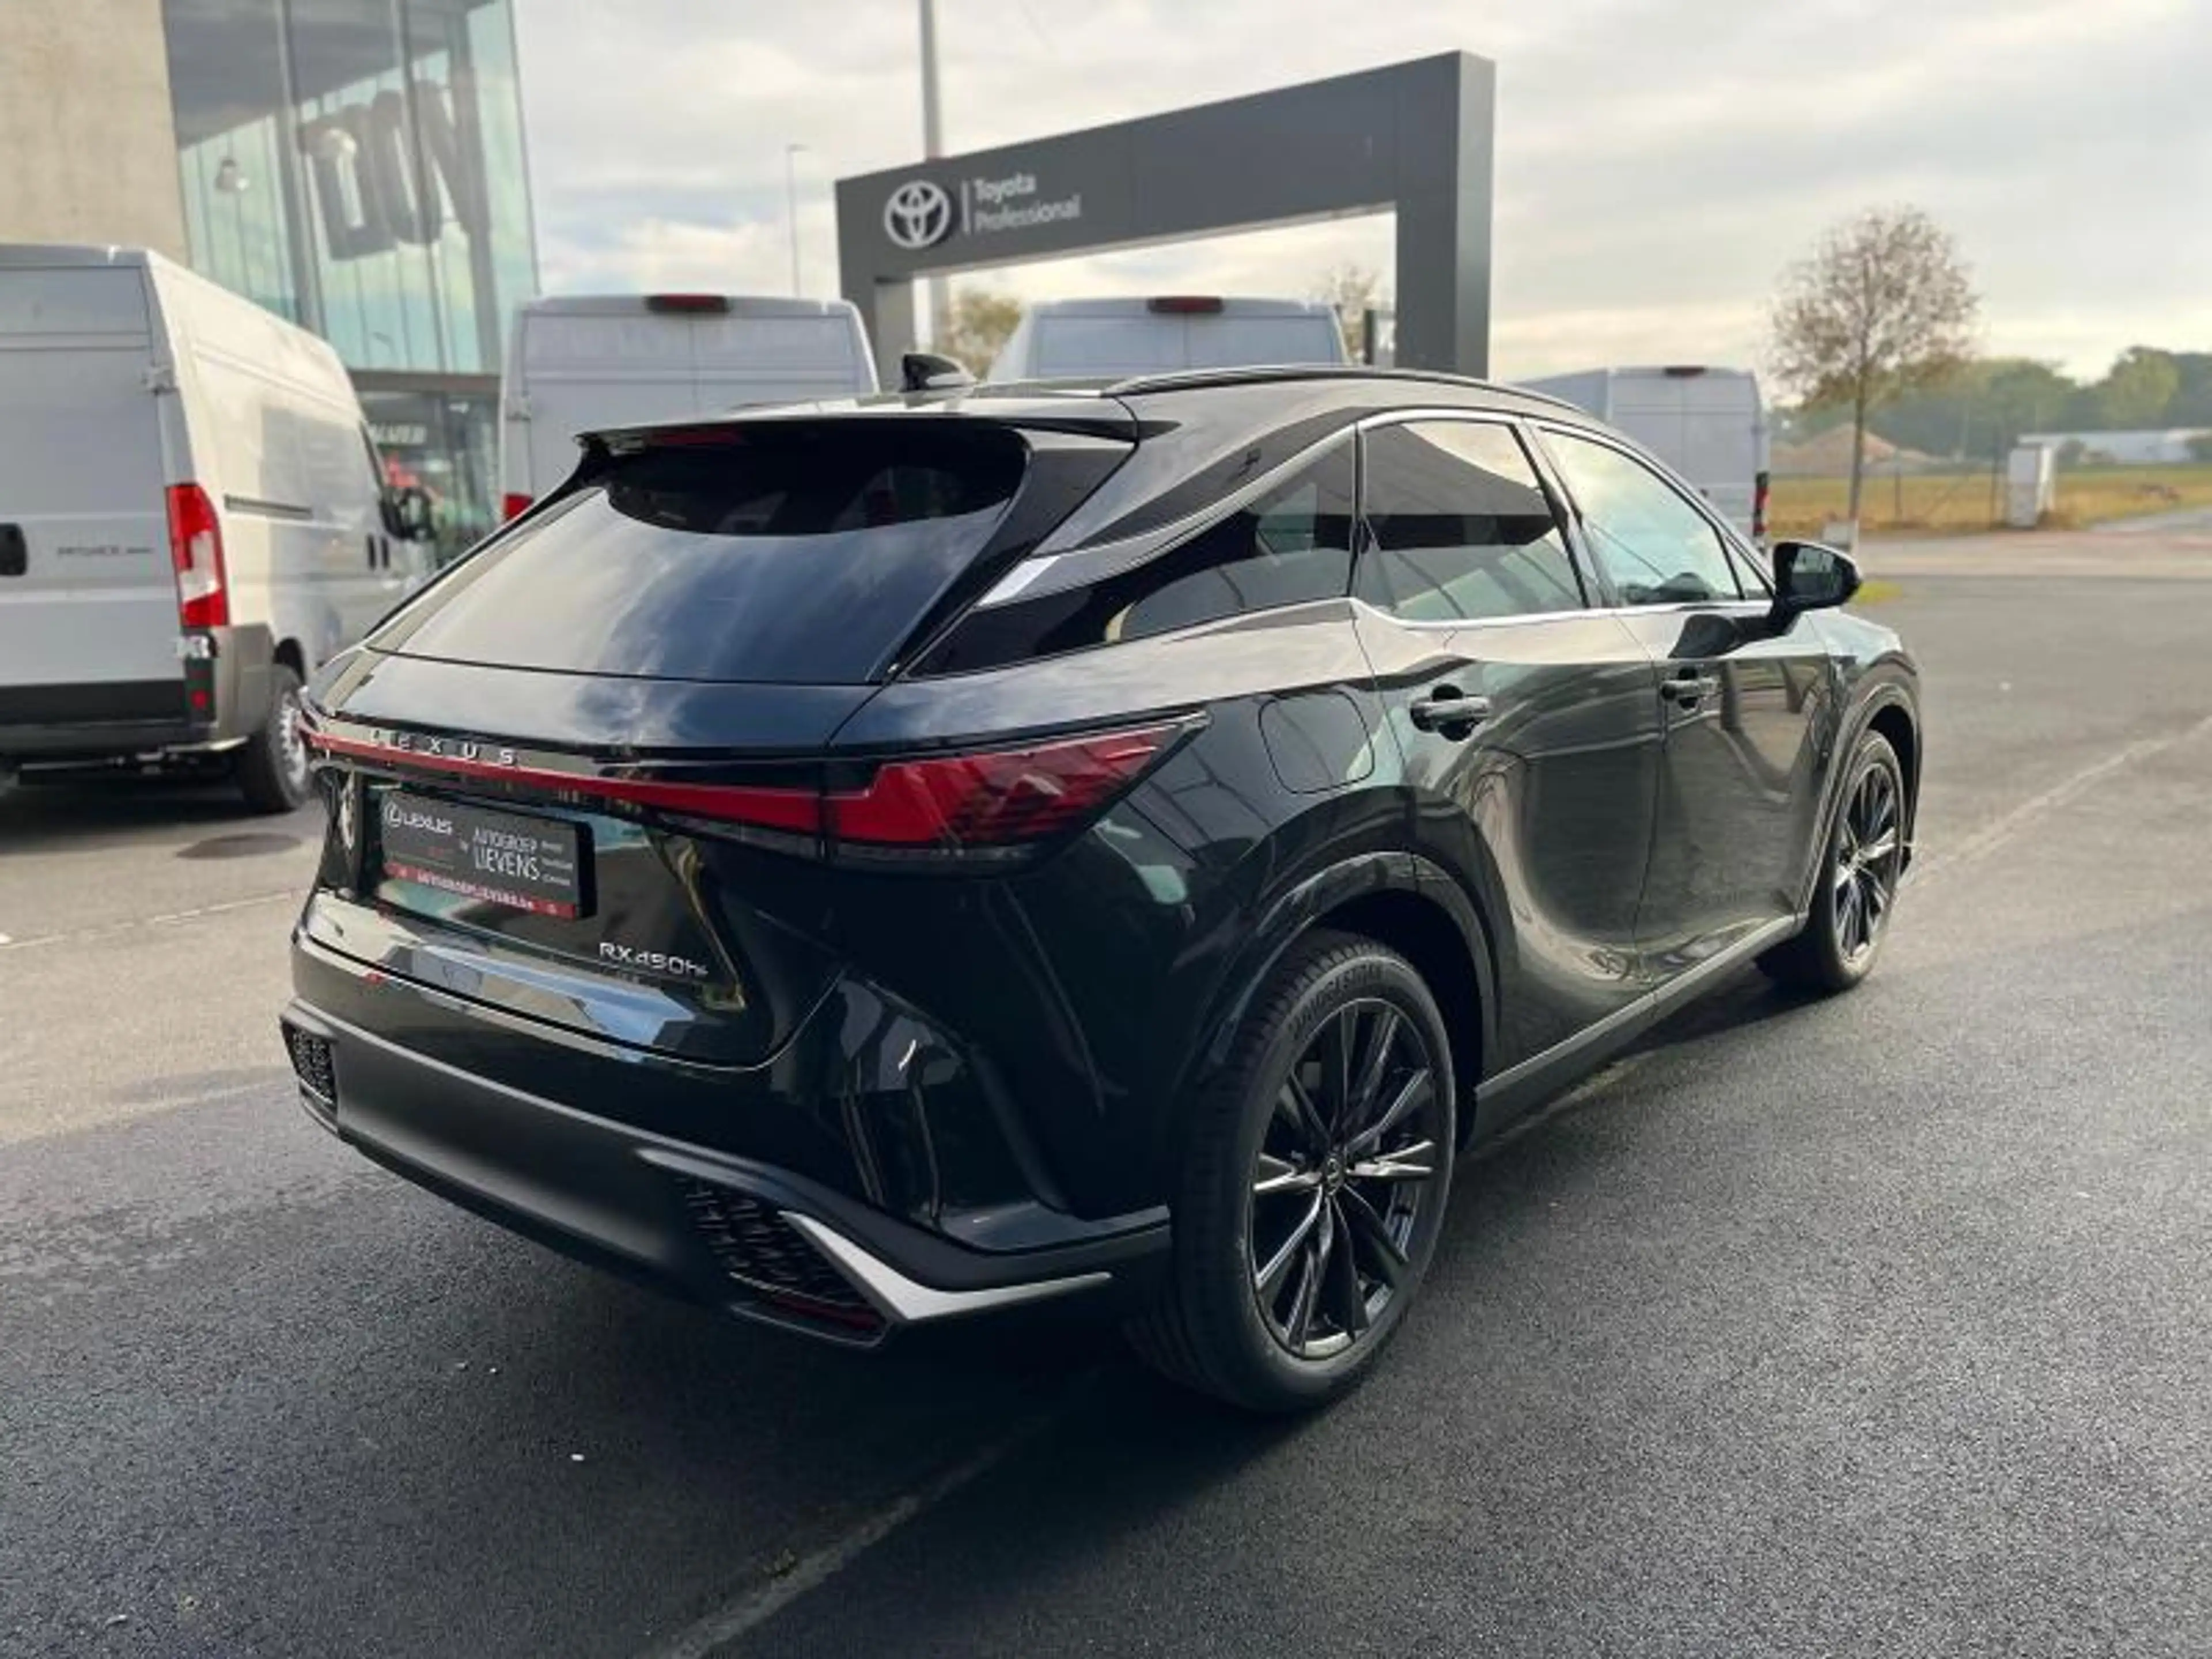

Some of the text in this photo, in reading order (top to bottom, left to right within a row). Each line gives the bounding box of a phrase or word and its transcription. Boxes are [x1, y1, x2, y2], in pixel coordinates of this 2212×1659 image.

[974, 172, 1037, 204] Toyota
[975, 193, 1082, 232] Professional
[403, 812, 452, 835] LEXUS
[599, 942, 632, 963] RX
